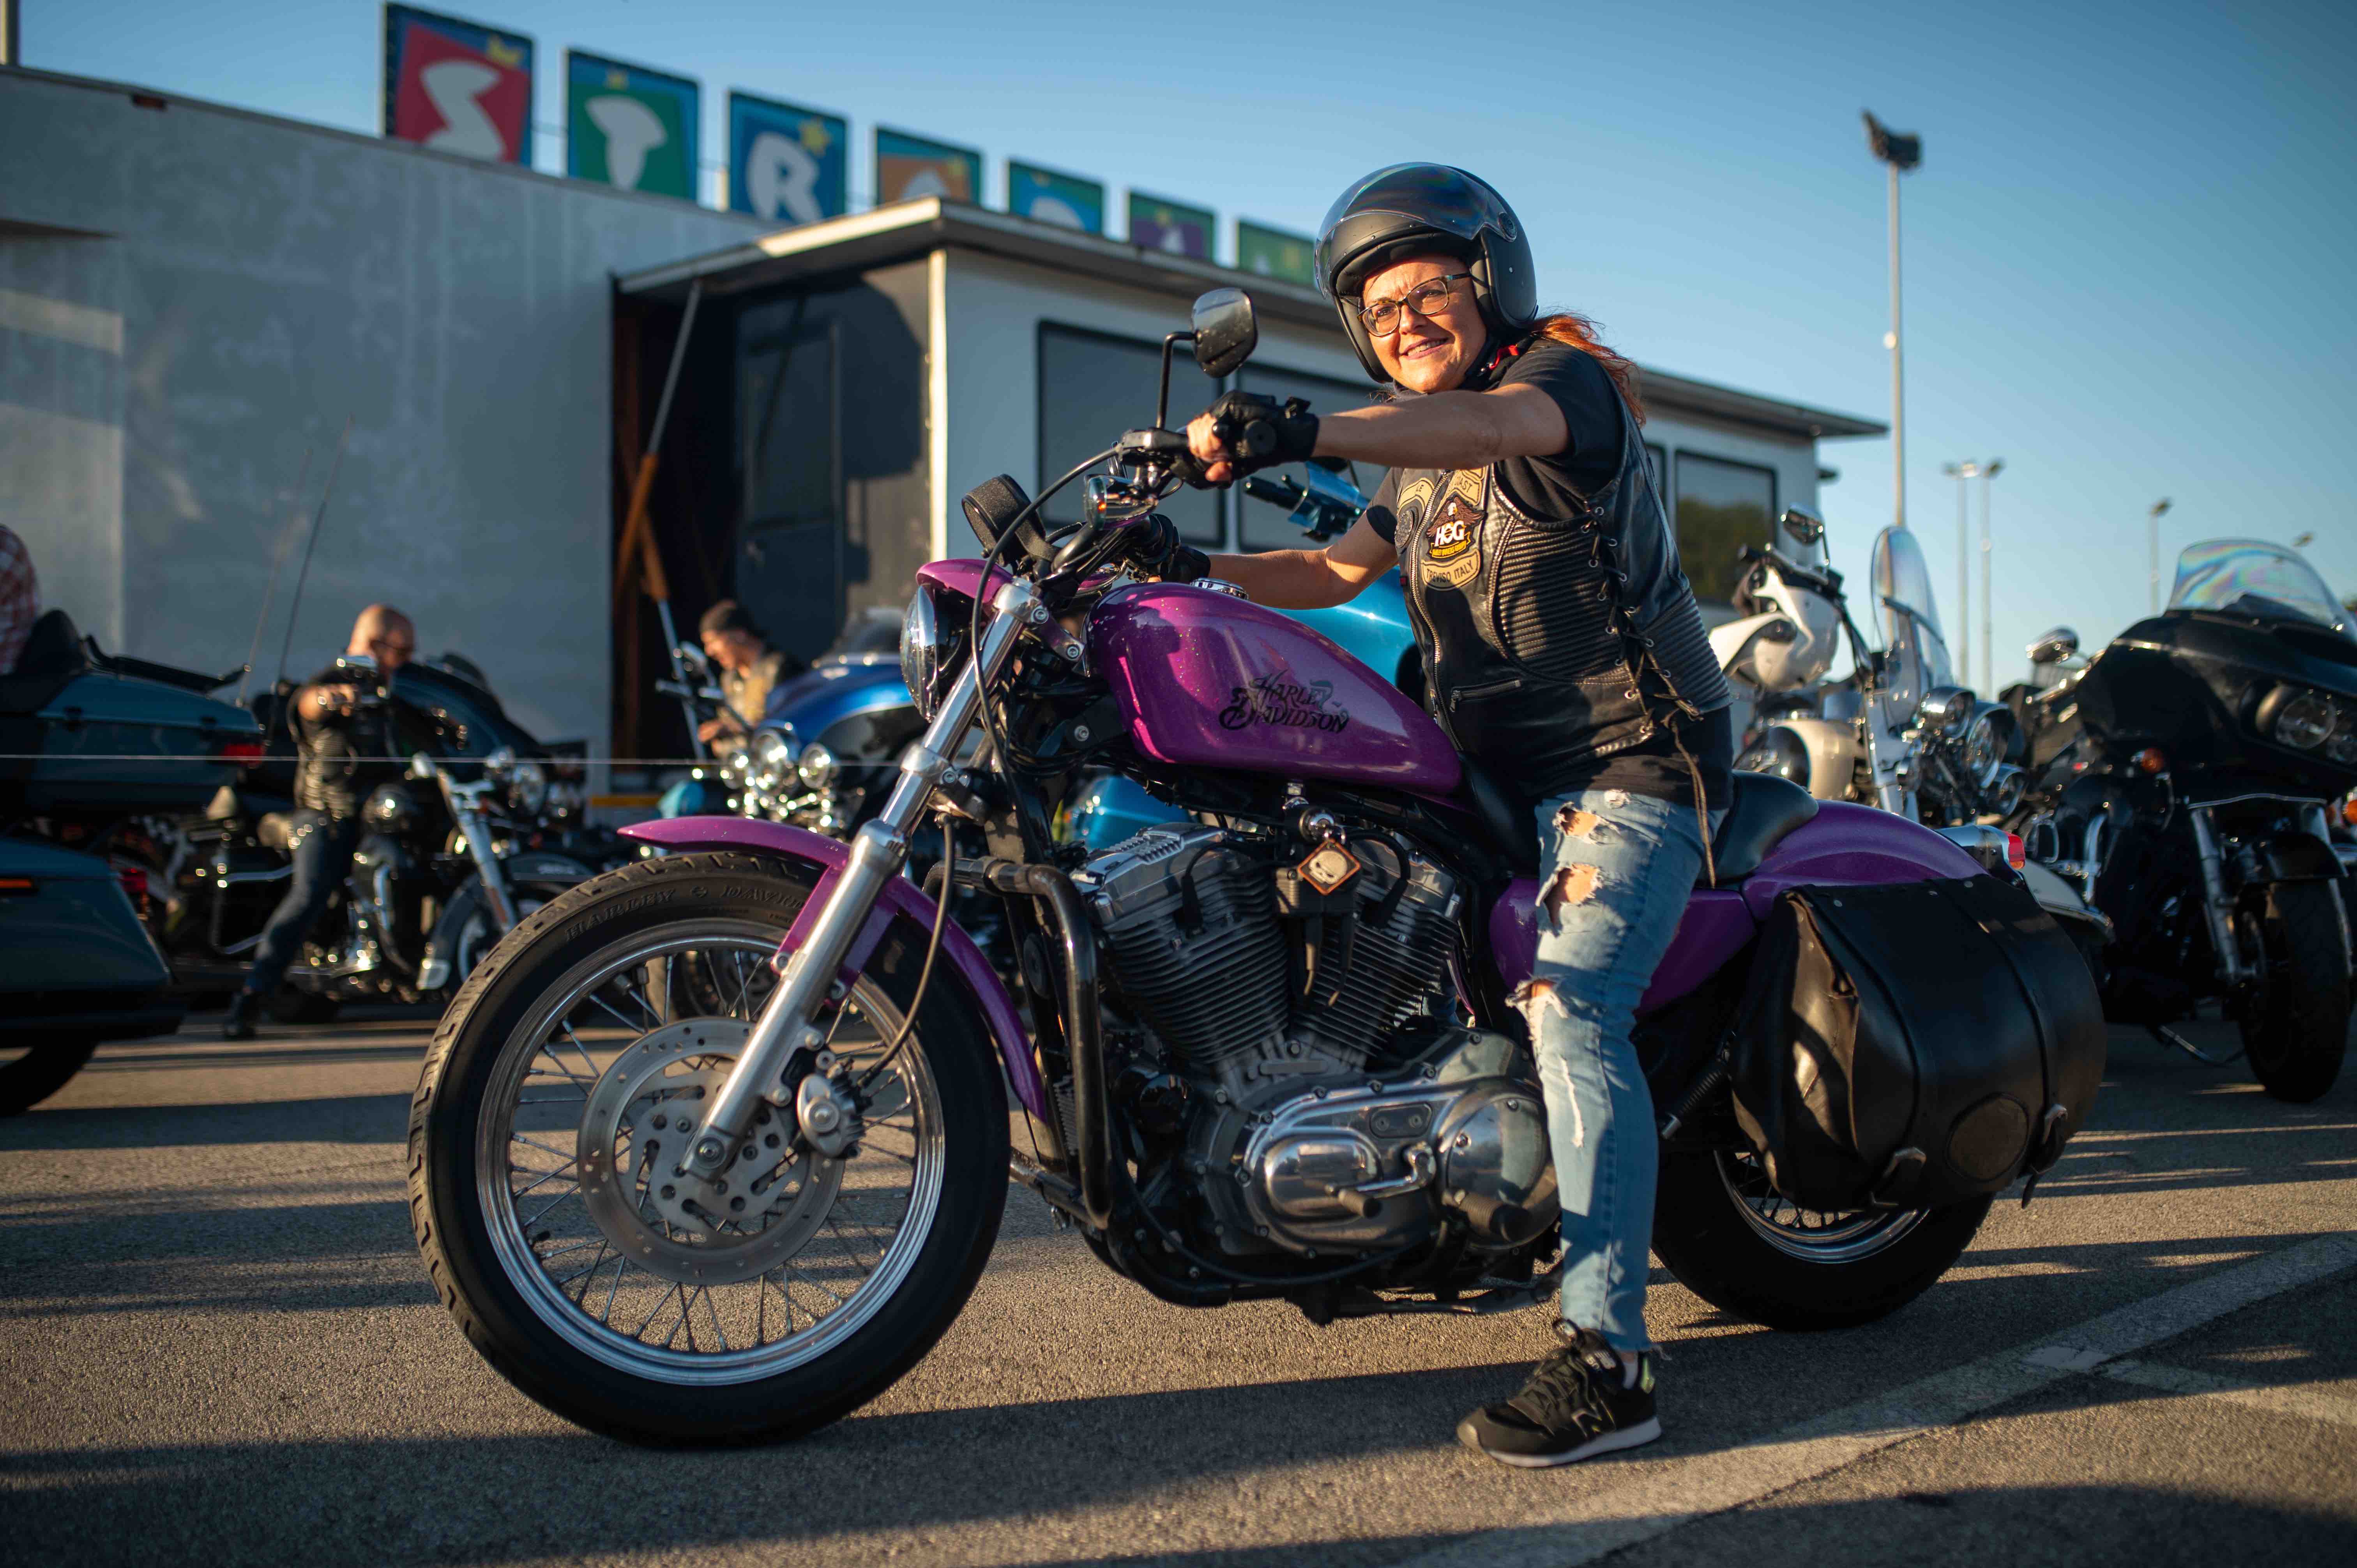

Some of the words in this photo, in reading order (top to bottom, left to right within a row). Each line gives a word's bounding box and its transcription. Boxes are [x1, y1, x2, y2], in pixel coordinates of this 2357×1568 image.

[1427, 568, 1451, 583] TREVISO
[1454, 560, 1473, 580] ITALY
[564, 888, 676, 942] HARLEY
[719, 885, 804, 909] DAVID
